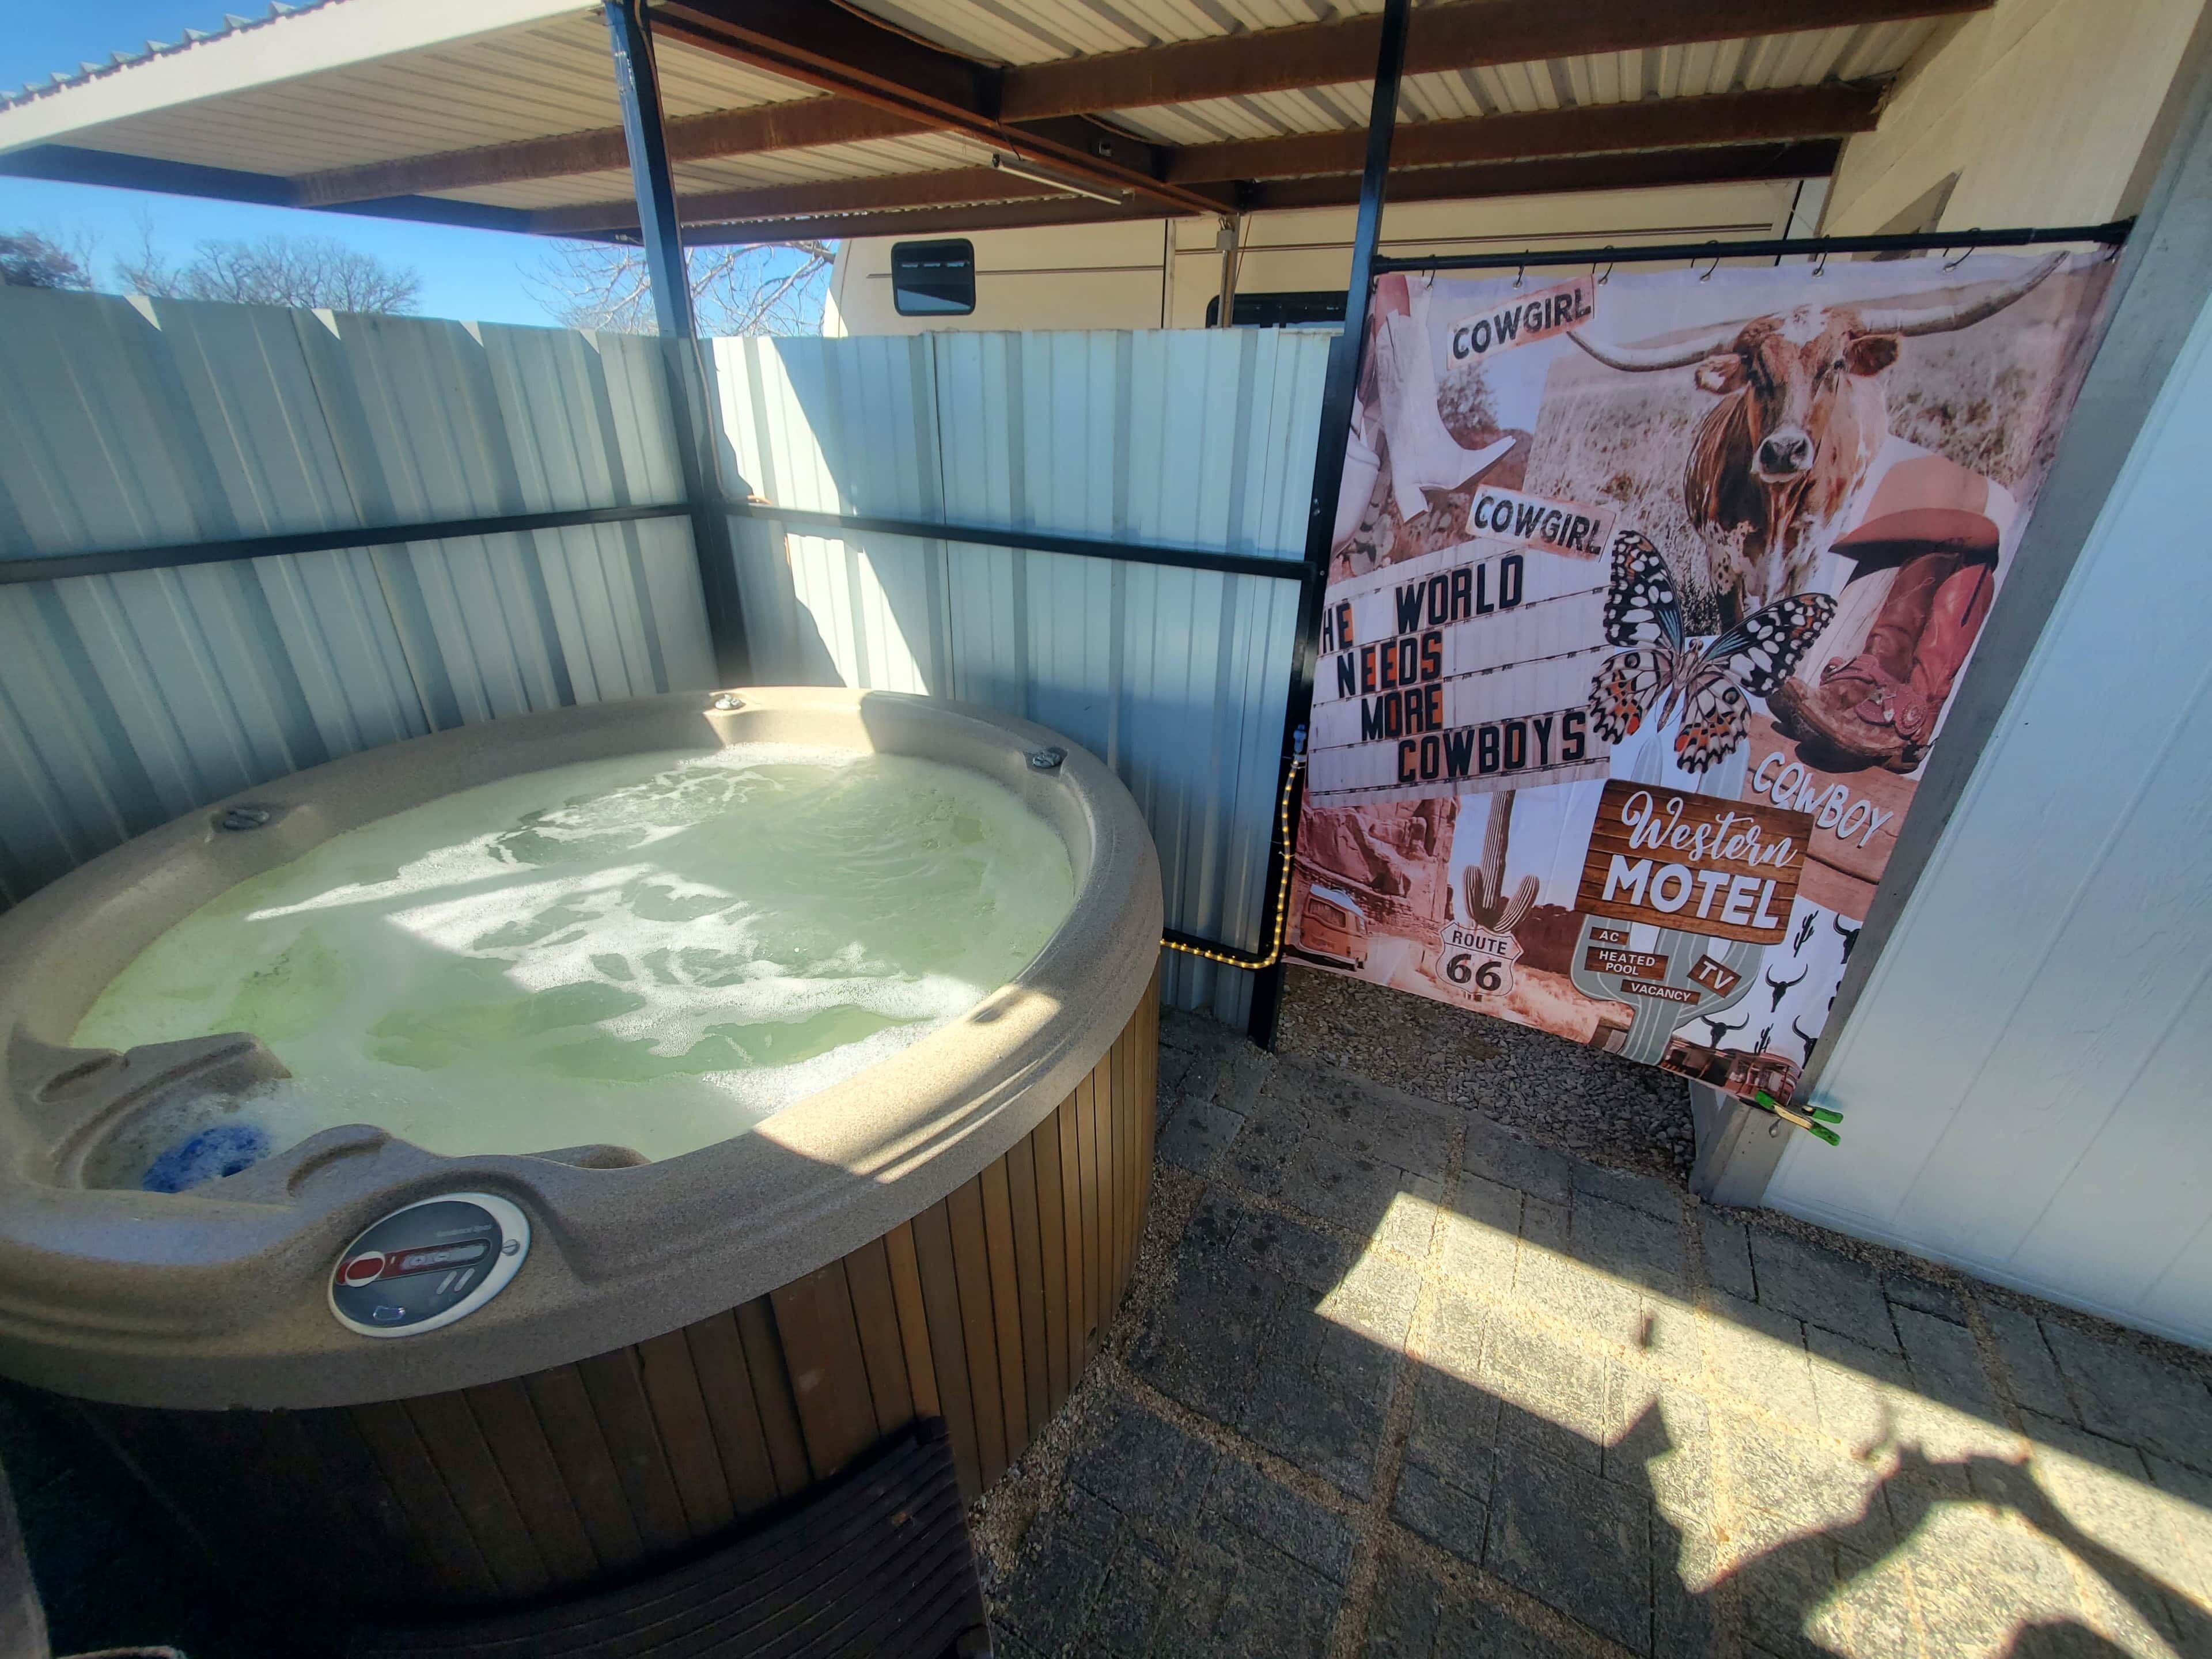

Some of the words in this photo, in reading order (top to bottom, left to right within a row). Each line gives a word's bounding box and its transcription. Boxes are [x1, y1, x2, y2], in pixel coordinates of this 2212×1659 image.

[1452, 288, 1592, 360] COWGIRL
[1474, 496, 1601, 554] COWGIRL
[1396, 554, 1524, 634] WORLD
[1337, 631, 1441, 698] NEEDS
[1361, 685, 1441, 741] MORE
[1398, 712, 1585, 782] COWBOYS
[1621, 790, 1797, 868] Western
[1753, 752, 1893, 849] COWBOY
[1602, 854, 1778, 929] MOTEL
[1452, 930, 1507, 955] ROUTE
[1599, 930, 1619, 942] AC
[1599, 950, 1655, 967] HEATED
[1446, 953, 1502, 991] 66
[1605, 963, 1639, 975] POOL
[1631, 983, 1691, 1002] VACANCY
[1699, 960, 1733, 990] TV
